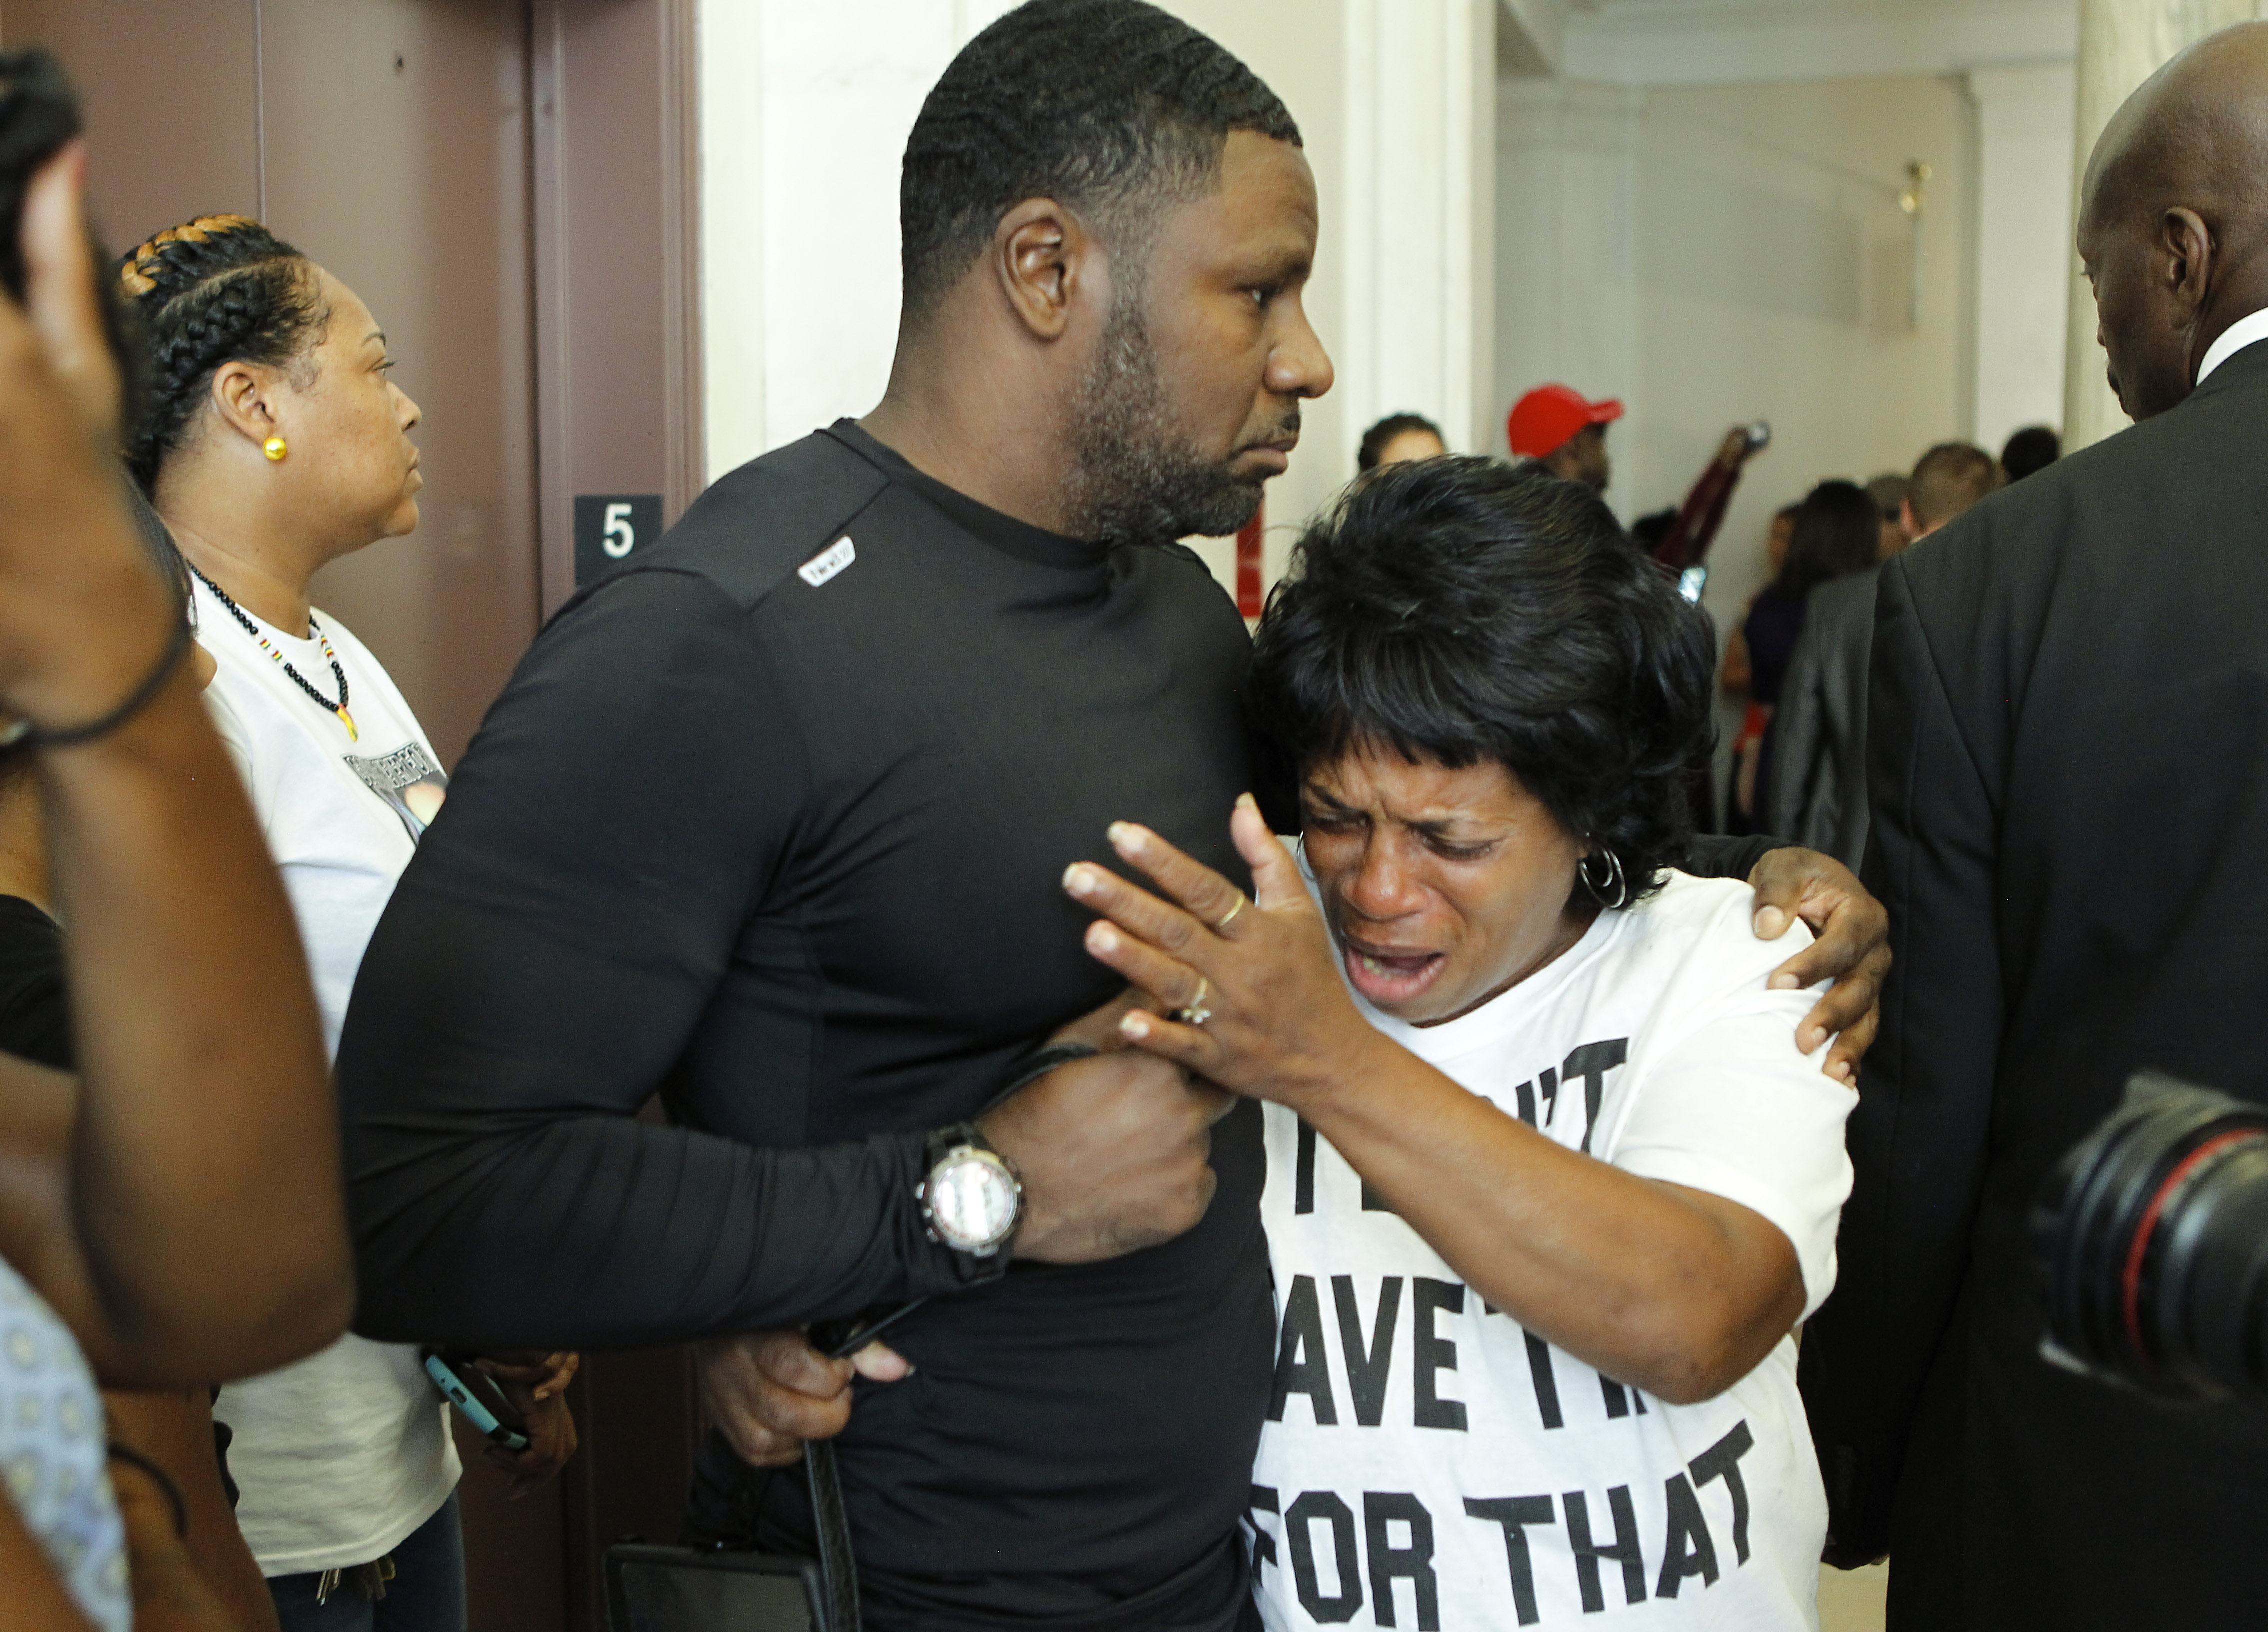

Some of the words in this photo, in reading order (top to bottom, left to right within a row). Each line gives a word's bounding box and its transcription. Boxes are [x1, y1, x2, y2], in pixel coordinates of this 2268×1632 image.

[603, 503, 635, 559] 5
[1266, 1273, 1469, 1434] AVE
[1244, 1484, 1441, 1632] FOR
[1462, 1418, 1756, 1628] THAT
